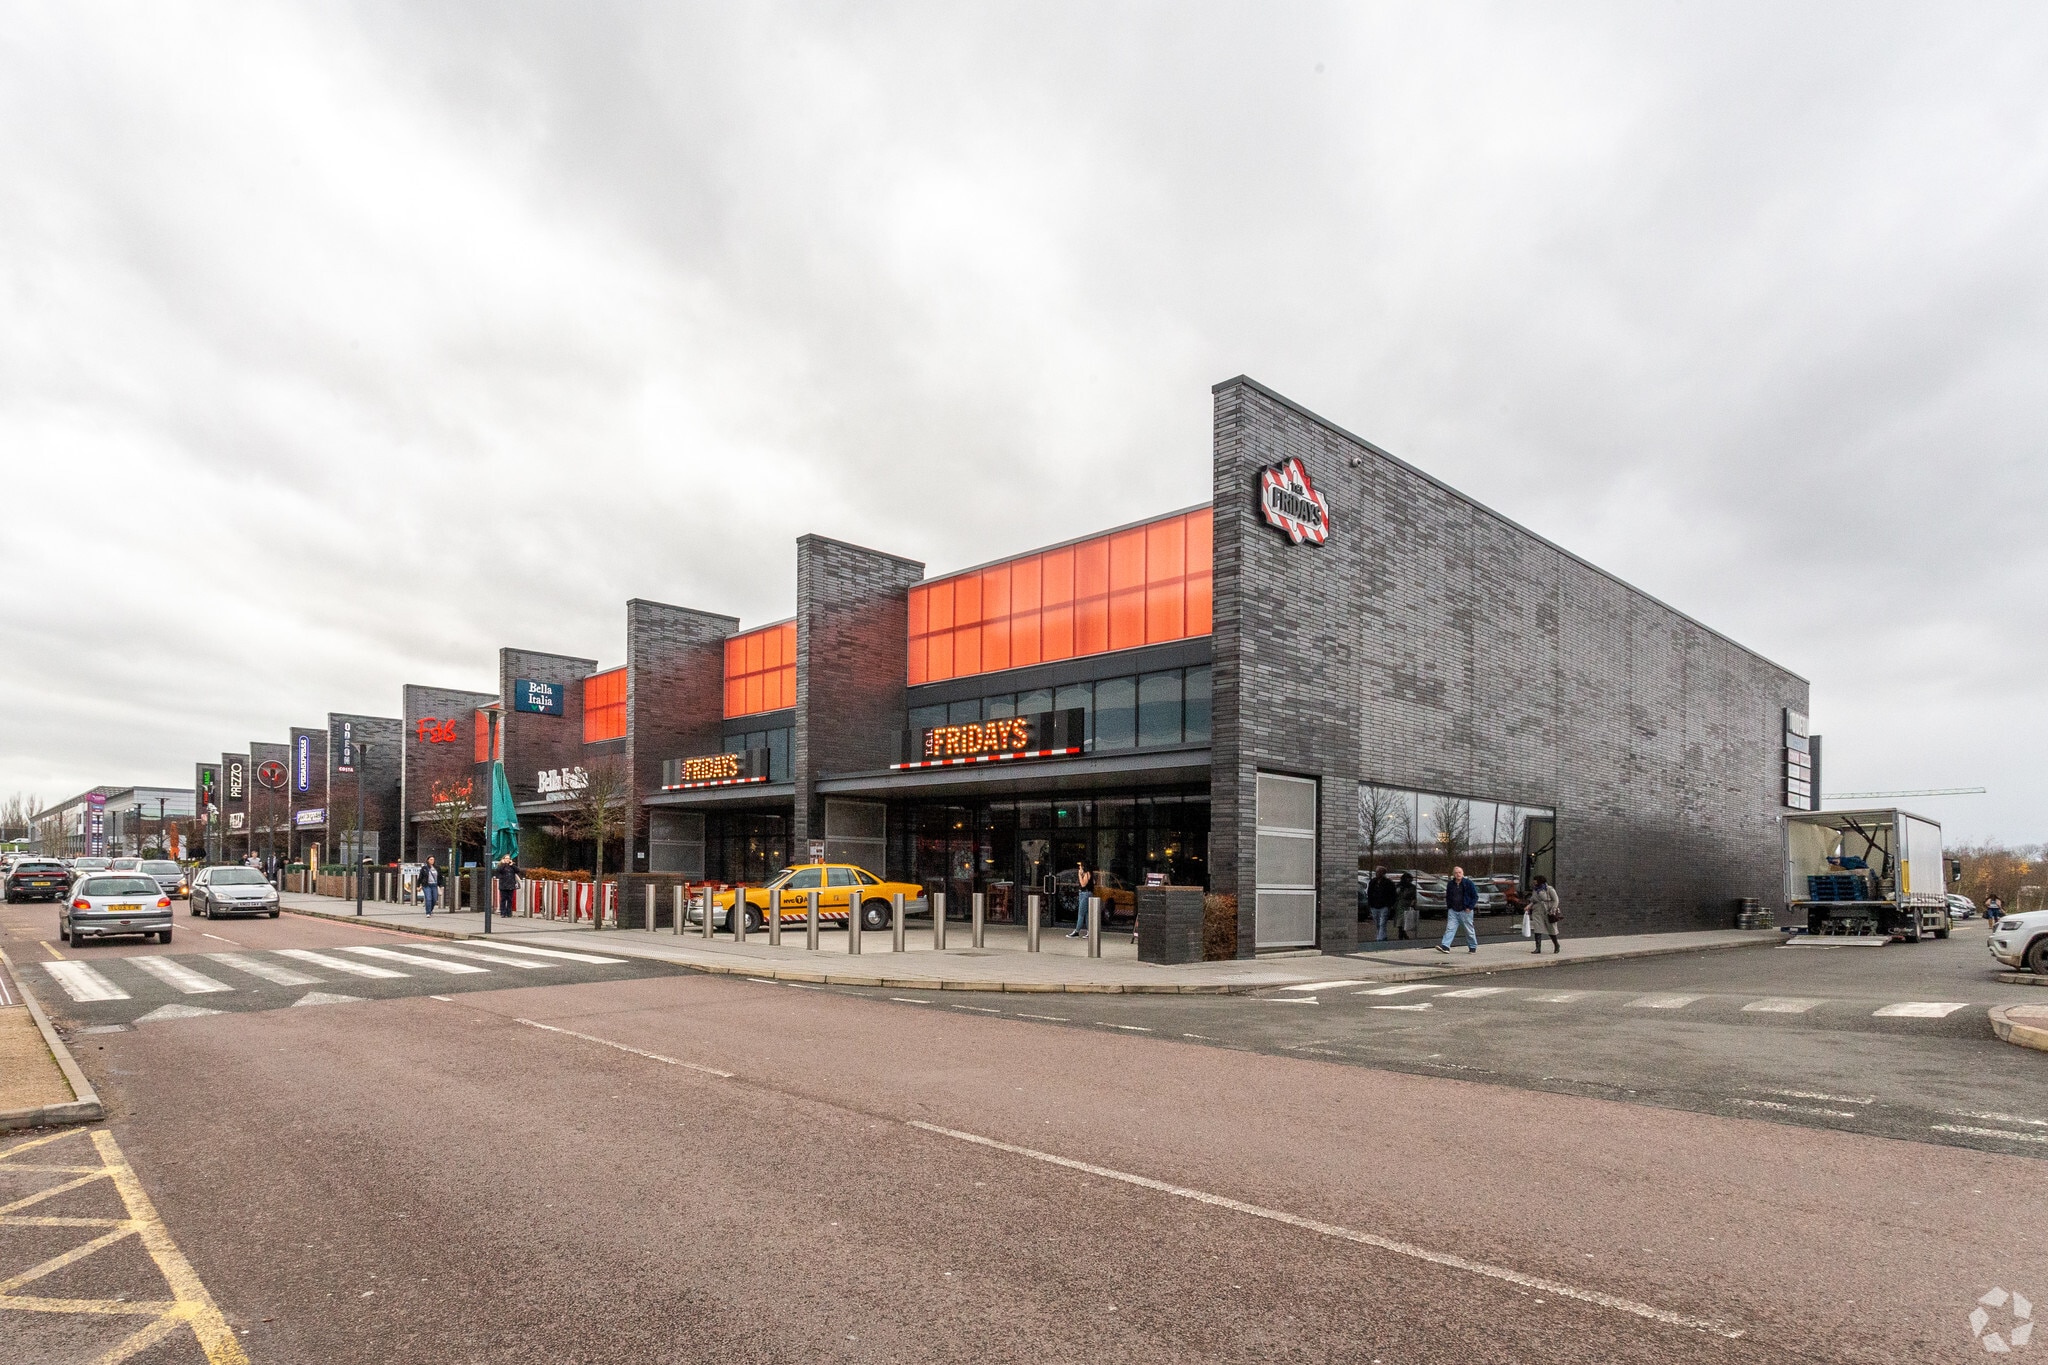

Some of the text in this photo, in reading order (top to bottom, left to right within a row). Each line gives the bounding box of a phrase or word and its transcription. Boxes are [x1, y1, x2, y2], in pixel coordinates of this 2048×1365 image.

[529, 682, 553, 695] Bella
[528, 694, 553, 706] Italia
[231, 763, 242, 797] PREZZO
[537, 769, 562, 793] Bella
